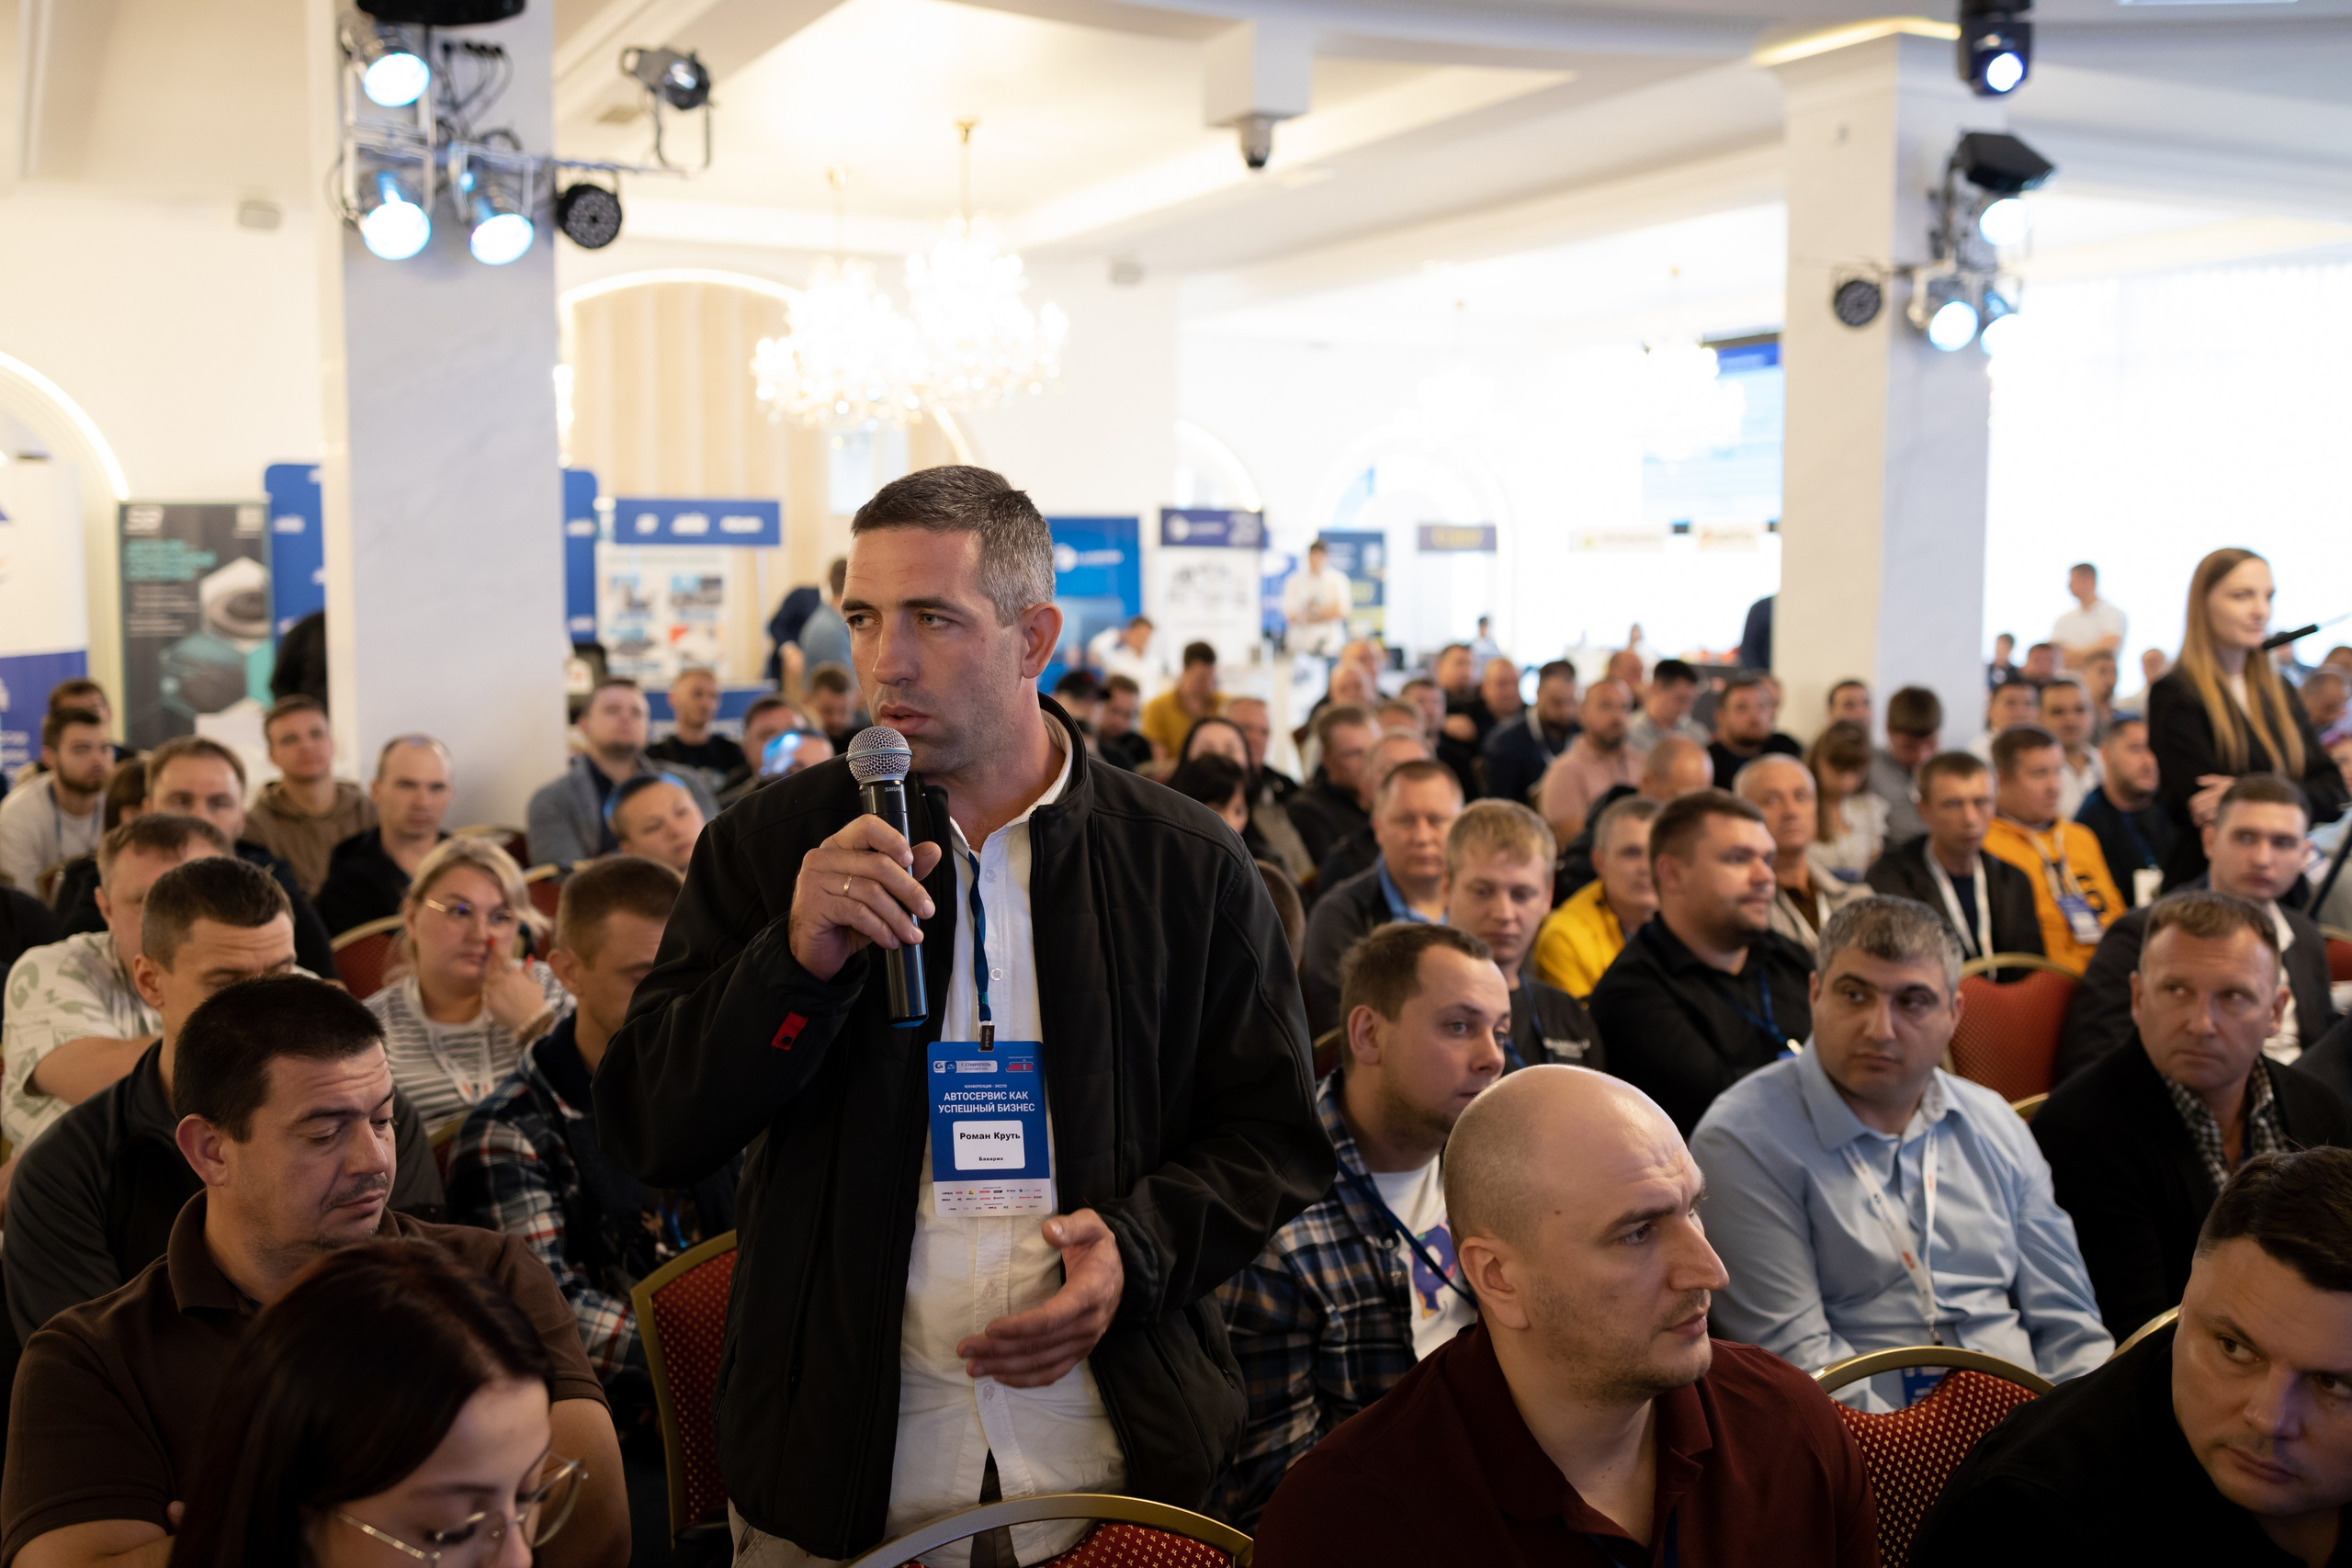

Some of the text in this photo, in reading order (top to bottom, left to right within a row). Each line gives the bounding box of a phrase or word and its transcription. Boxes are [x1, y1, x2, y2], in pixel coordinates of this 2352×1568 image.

[944, 1091, 1028, 1101] АВТОСЕРВИС КАК
[938, 1102, 1035, 1113] УСПЕШНЫЙ БИЗНЕС
[993, 1132, 1021, 1141] Круть
